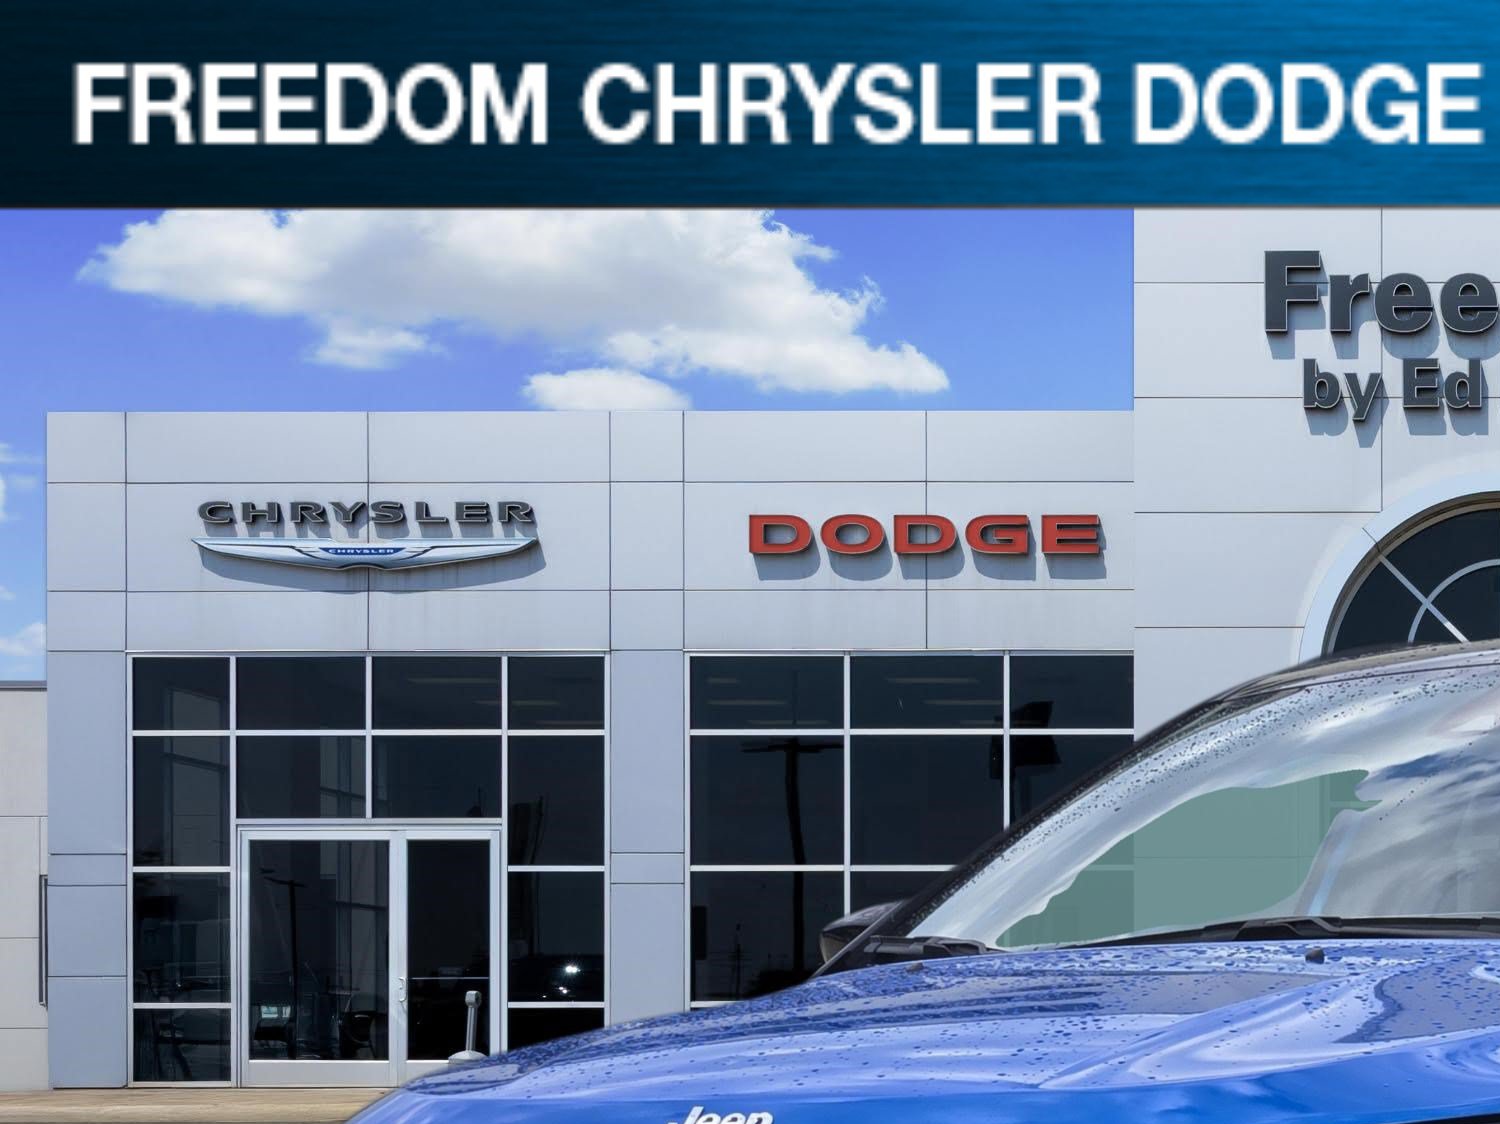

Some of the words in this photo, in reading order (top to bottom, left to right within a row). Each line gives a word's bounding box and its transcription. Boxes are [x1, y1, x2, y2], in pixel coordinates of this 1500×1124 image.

[1302, 357, 1382, 421] by
[1402, 358, 1482, 409] Ed
[197, 500, 534, 524] CHRYSLER
[748, 513, 1101, 555] DODGE
